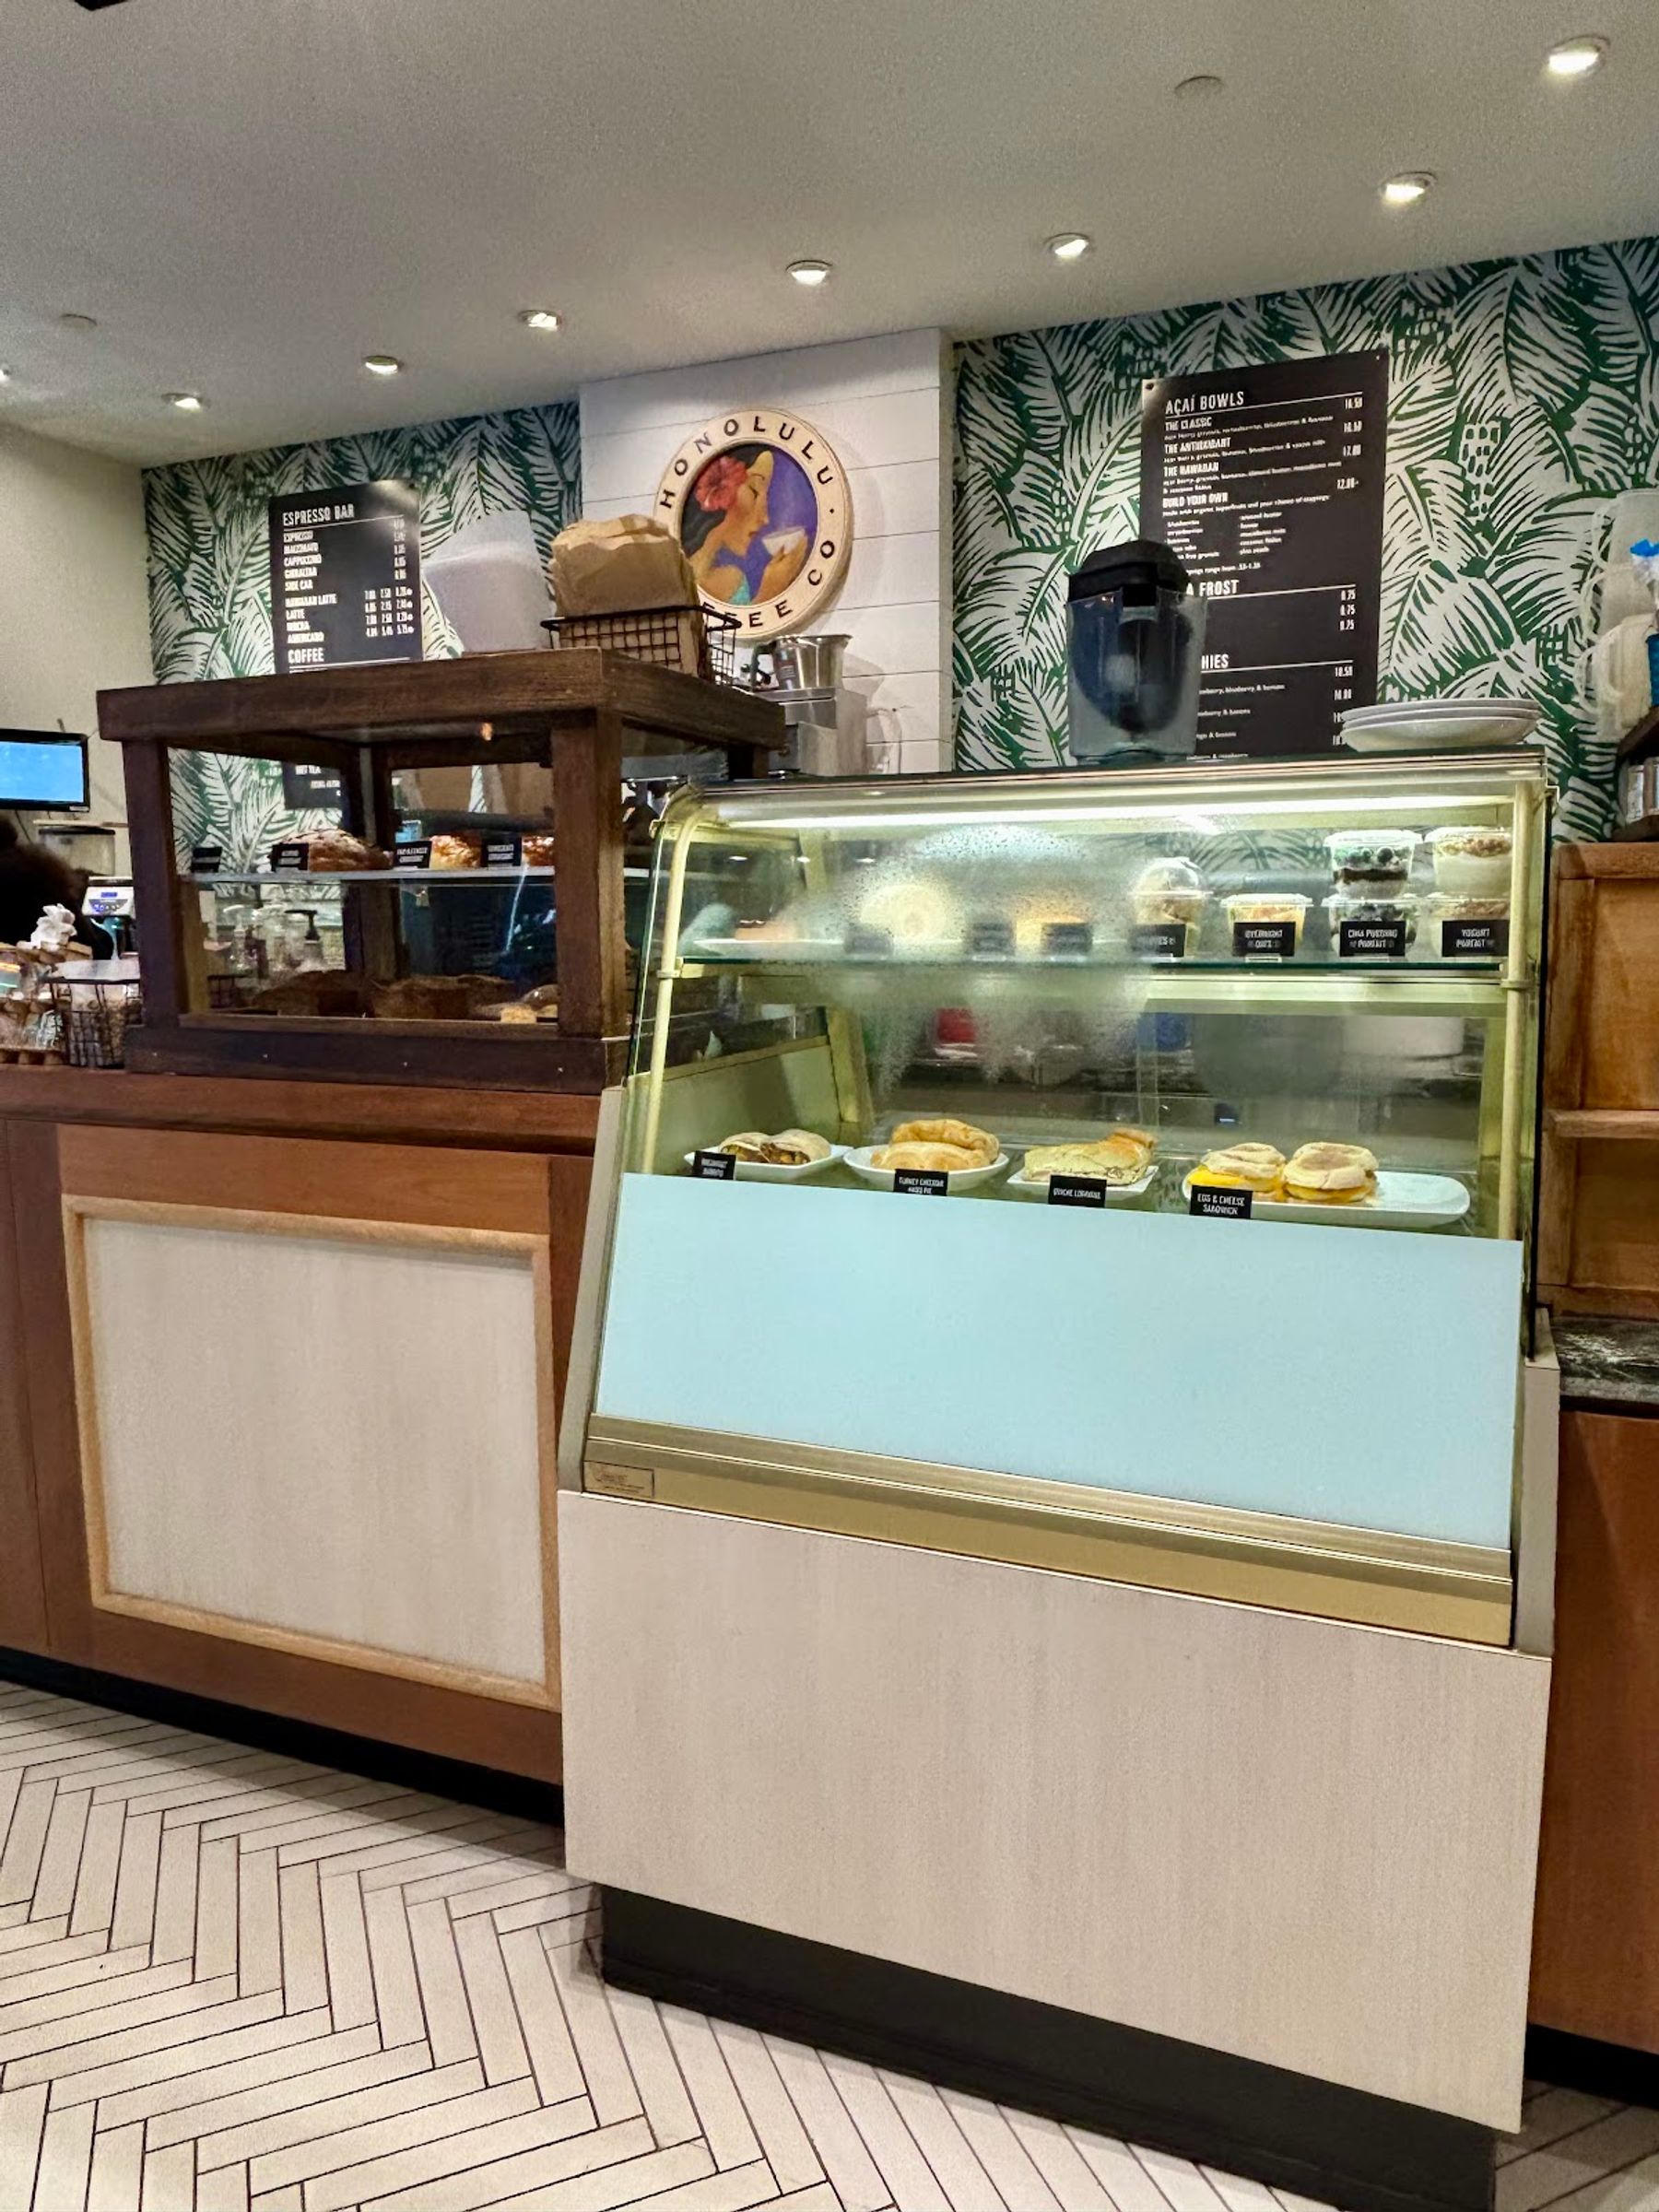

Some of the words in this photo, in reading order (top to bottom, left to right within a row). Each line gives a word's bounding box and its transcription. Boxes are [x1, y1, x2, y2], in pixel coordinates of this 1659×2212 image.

[1200, 391, 1244, 410] BOWLS
[1165, 419, 1179, 431] THE
[1181, 417, 1212, 429] CLASSIC
[1164, 443, 1178, 454] THE
[660, 416, 833, 509] HONOLULU
[1163, 465, 1177, 477] THE
[1162, 496, 1185, 509] BUILD
[1186, 493, 1206, 506] YOUR
[1208, 491, 1229, 504] OWN
[283, 507, 331, 526] ESPRESSO
[335, 503, 355, 520] BAR
[284, 553, 322, 567] CAPPUCCINO
[1199, 579, 1240, 597] FROST
[318, 594, 337, 605] LATTE
[286, 608, 306, 620] LATTE
[288, 647, 324, 664] COFFEE
[1201, 653, 1230, 669] HIES
[1461, 927, 1490, 937] YOGURT
[1455, 938, 1485, 948] PARFAIT
[1053, 1187, 1074, 1197] QUICHE
[1197, 1193, 1211, 1203] EGG
[1219, 1195, 1245, 1206] CHEESE
[1203, 1203, 1238, 1216] SANDWICH
